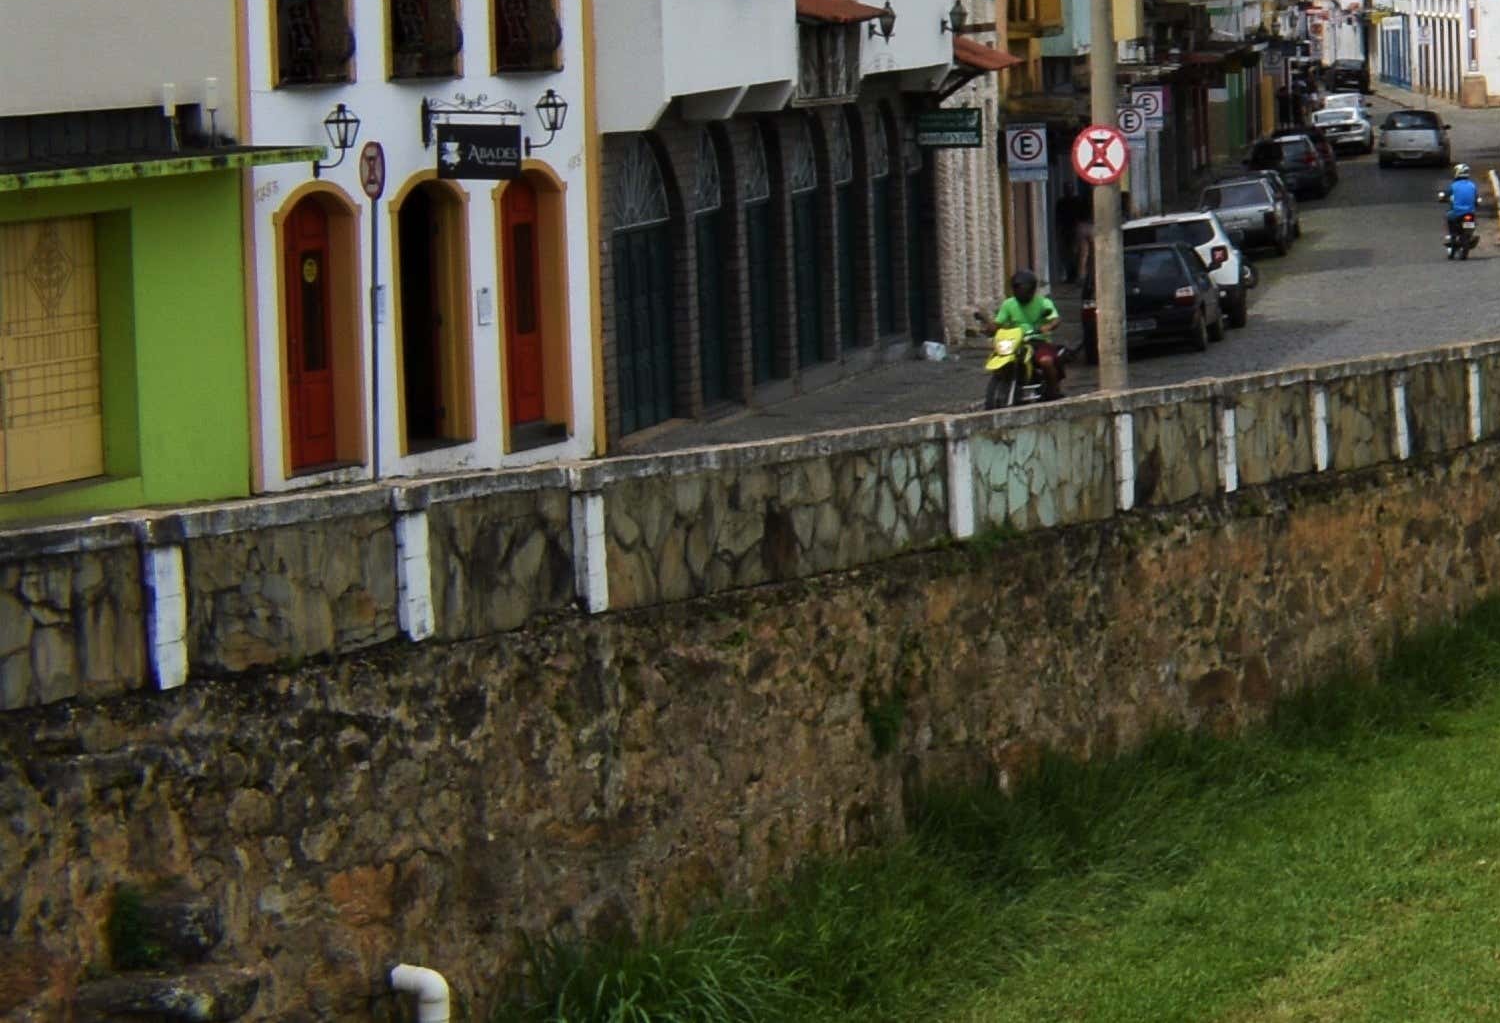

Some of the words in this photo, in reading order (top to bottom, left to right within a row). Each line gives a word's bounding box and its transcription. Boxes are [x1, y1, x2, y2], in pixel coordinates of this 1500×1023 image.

[1143, 97, 1151, 111] E
[1124, 113, 1134, 129] E
[1020, 135, 1033, 155] E
